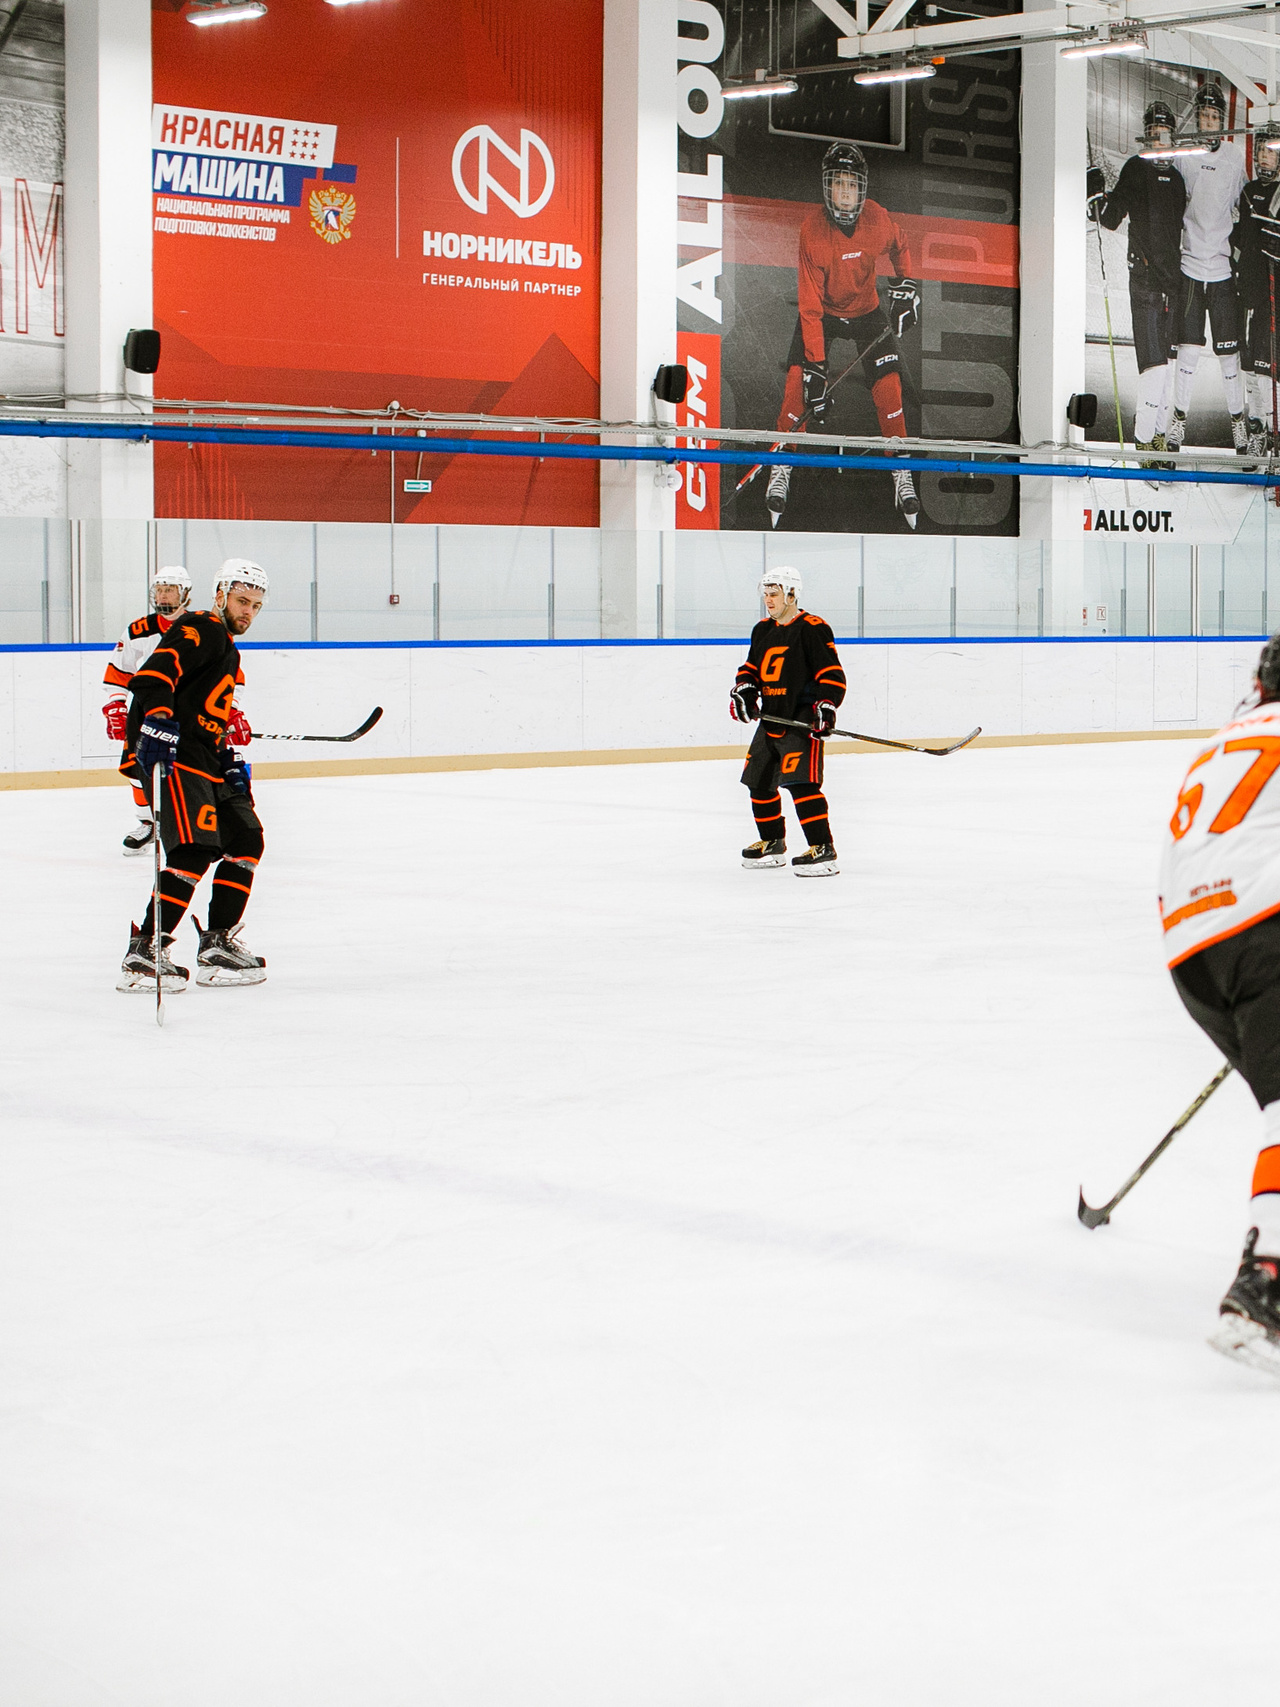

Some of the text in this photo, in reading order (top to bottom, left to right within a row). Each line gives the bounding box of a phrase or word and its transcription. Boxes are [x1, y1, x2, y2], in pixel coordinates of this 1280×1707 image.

[160, 113, 285, 155] КРАСНАЯ
[153, 153, 285, 202] МАШИНА
[156, 197, 290, 224] НАЦИОНАЛЬНАЯ ПРОГРАММА
[154, 217, 276, 241] ПОДГОТОВКИ ХОККЕИСТОВ
[677, 154, 723, 324] ALL
[423, 230, 582, 269] НОРНИКЕЛЬ
[842, 251, 862, 261] CCM
[422, 272, 581, 296] ГЕНЕРАЛЬНЫЙ ПАРТНЕР
[888, 290, 915, 300] CM
[1217, 340, 1238, 349] CCM
[875, 354, 898, 367] CCM
[1254, 360, 1271, 368] CCM
[788, 412, 800, 422] CC
[1094, 510, 1174, 532] ALL OUT.
